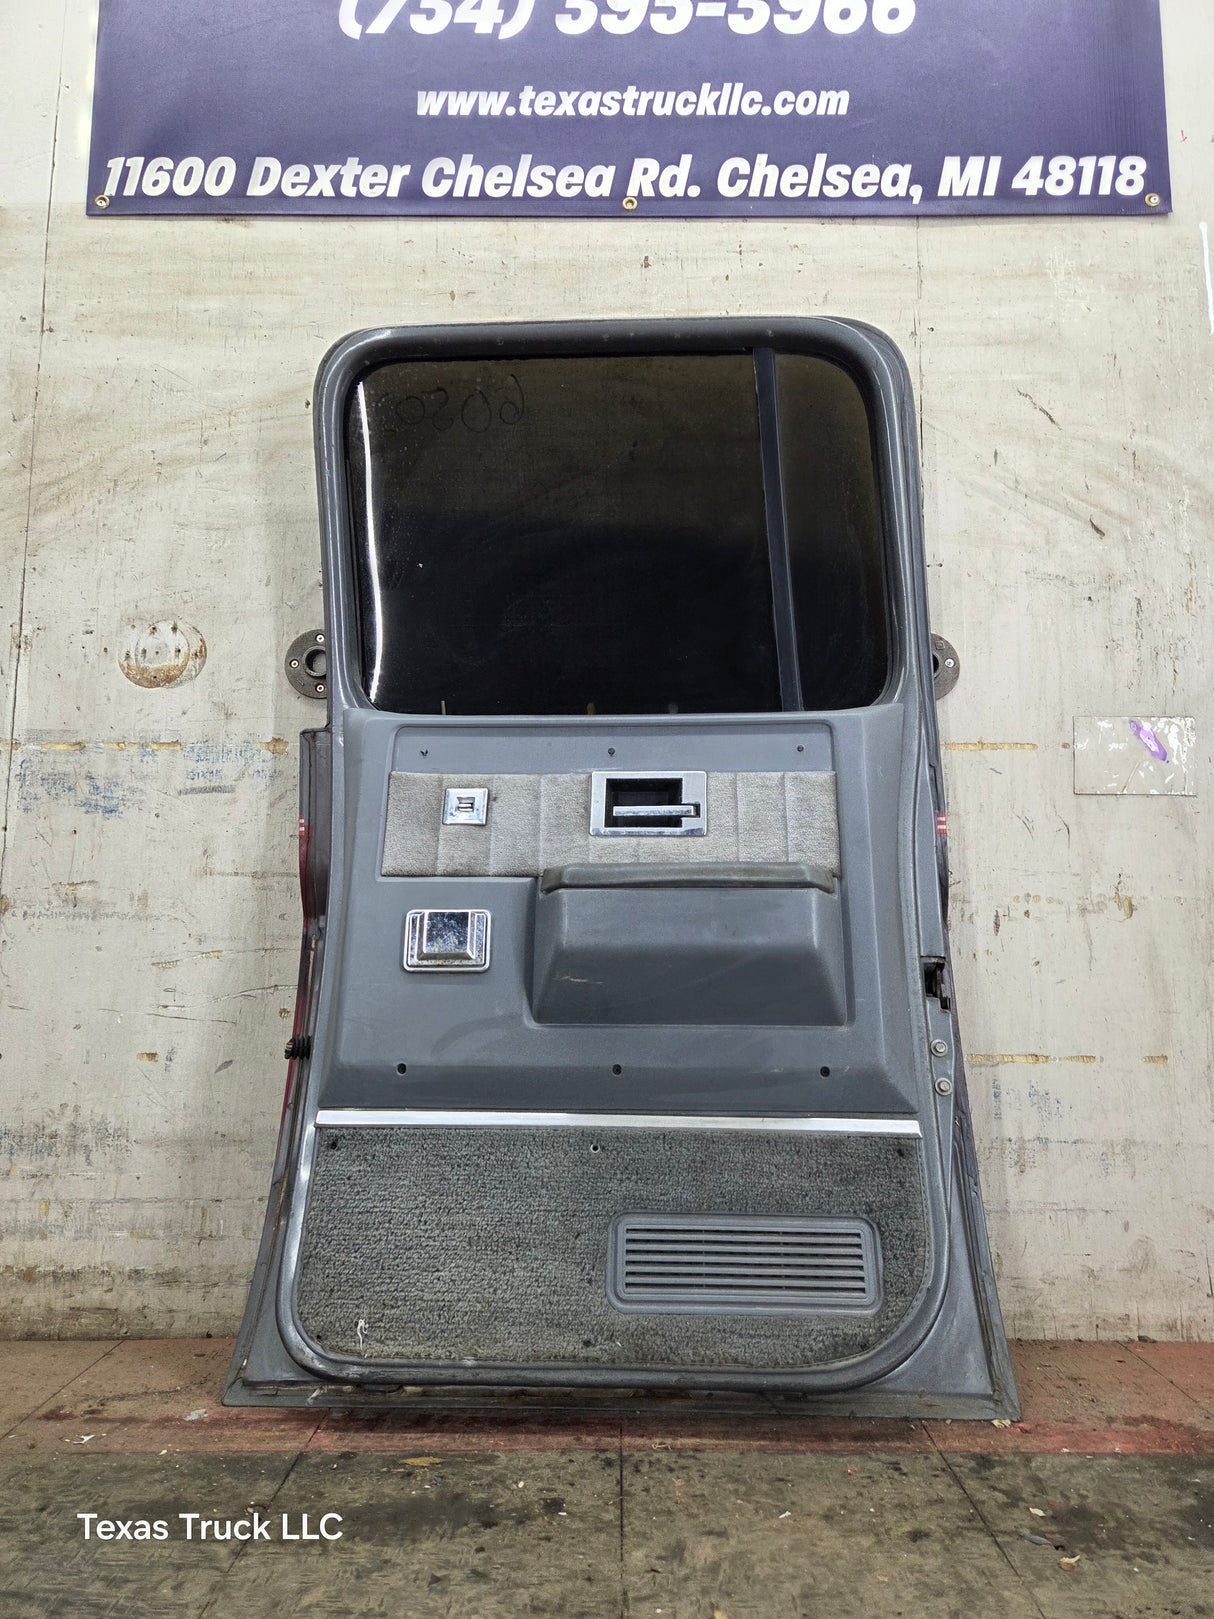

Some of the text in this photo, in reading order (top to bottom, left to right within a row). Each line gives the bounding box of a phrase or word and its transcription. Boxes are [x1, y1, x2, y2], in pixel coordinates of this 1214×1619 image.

[416, 82, 850, 117] www.texastruckllc.com
[104, 153, 1147, 205] 11600 Dexter Chelsea Rd. Chelsea, MI 48118
